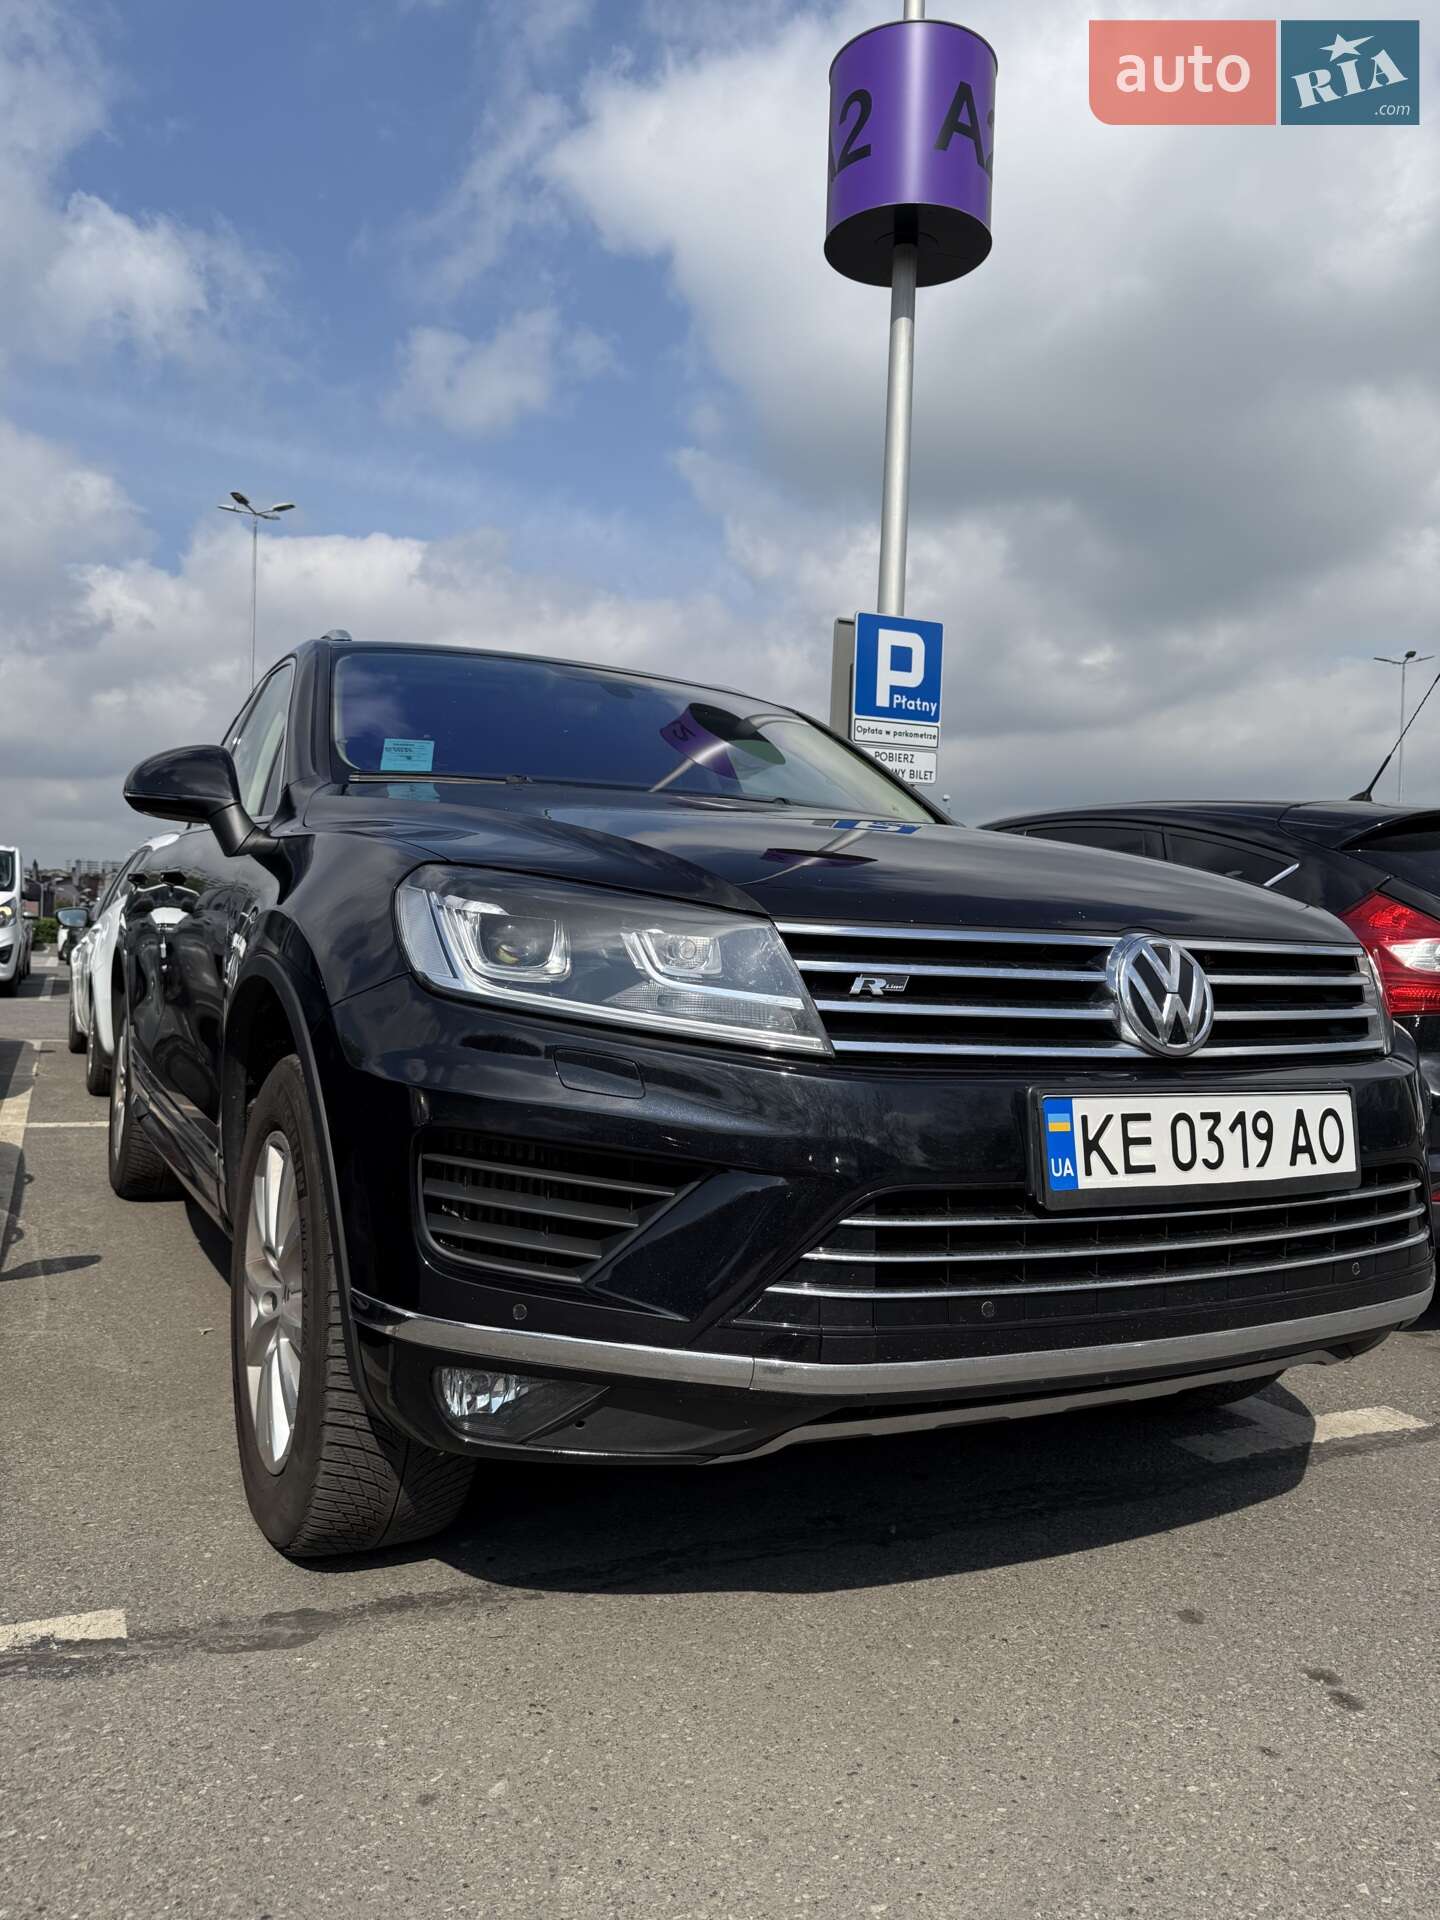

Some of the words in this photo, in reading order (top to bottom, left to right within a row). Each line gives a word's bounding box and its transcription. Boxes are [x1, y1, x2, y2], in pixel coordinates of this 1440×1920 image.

[829, 88, 873, 181] 2
[934, 80, 992, 180] A
[876, 628, 926, 708] P
[893, 694, 937, 717] Płatny
[856, 725, 883, 736] Opłata
[893, 730, 937, 741] parkometrze
[875, 751, 915, 764] POBIERZ
[909, 769, 934, 781] BILET
[1051, 1157, 1074, 1178] UA
[1080, 1112, 1157, 1177] KE
[1170, 1109, 1274, 1172] 0319
[1289, 1107, 1345, 1167] AO
